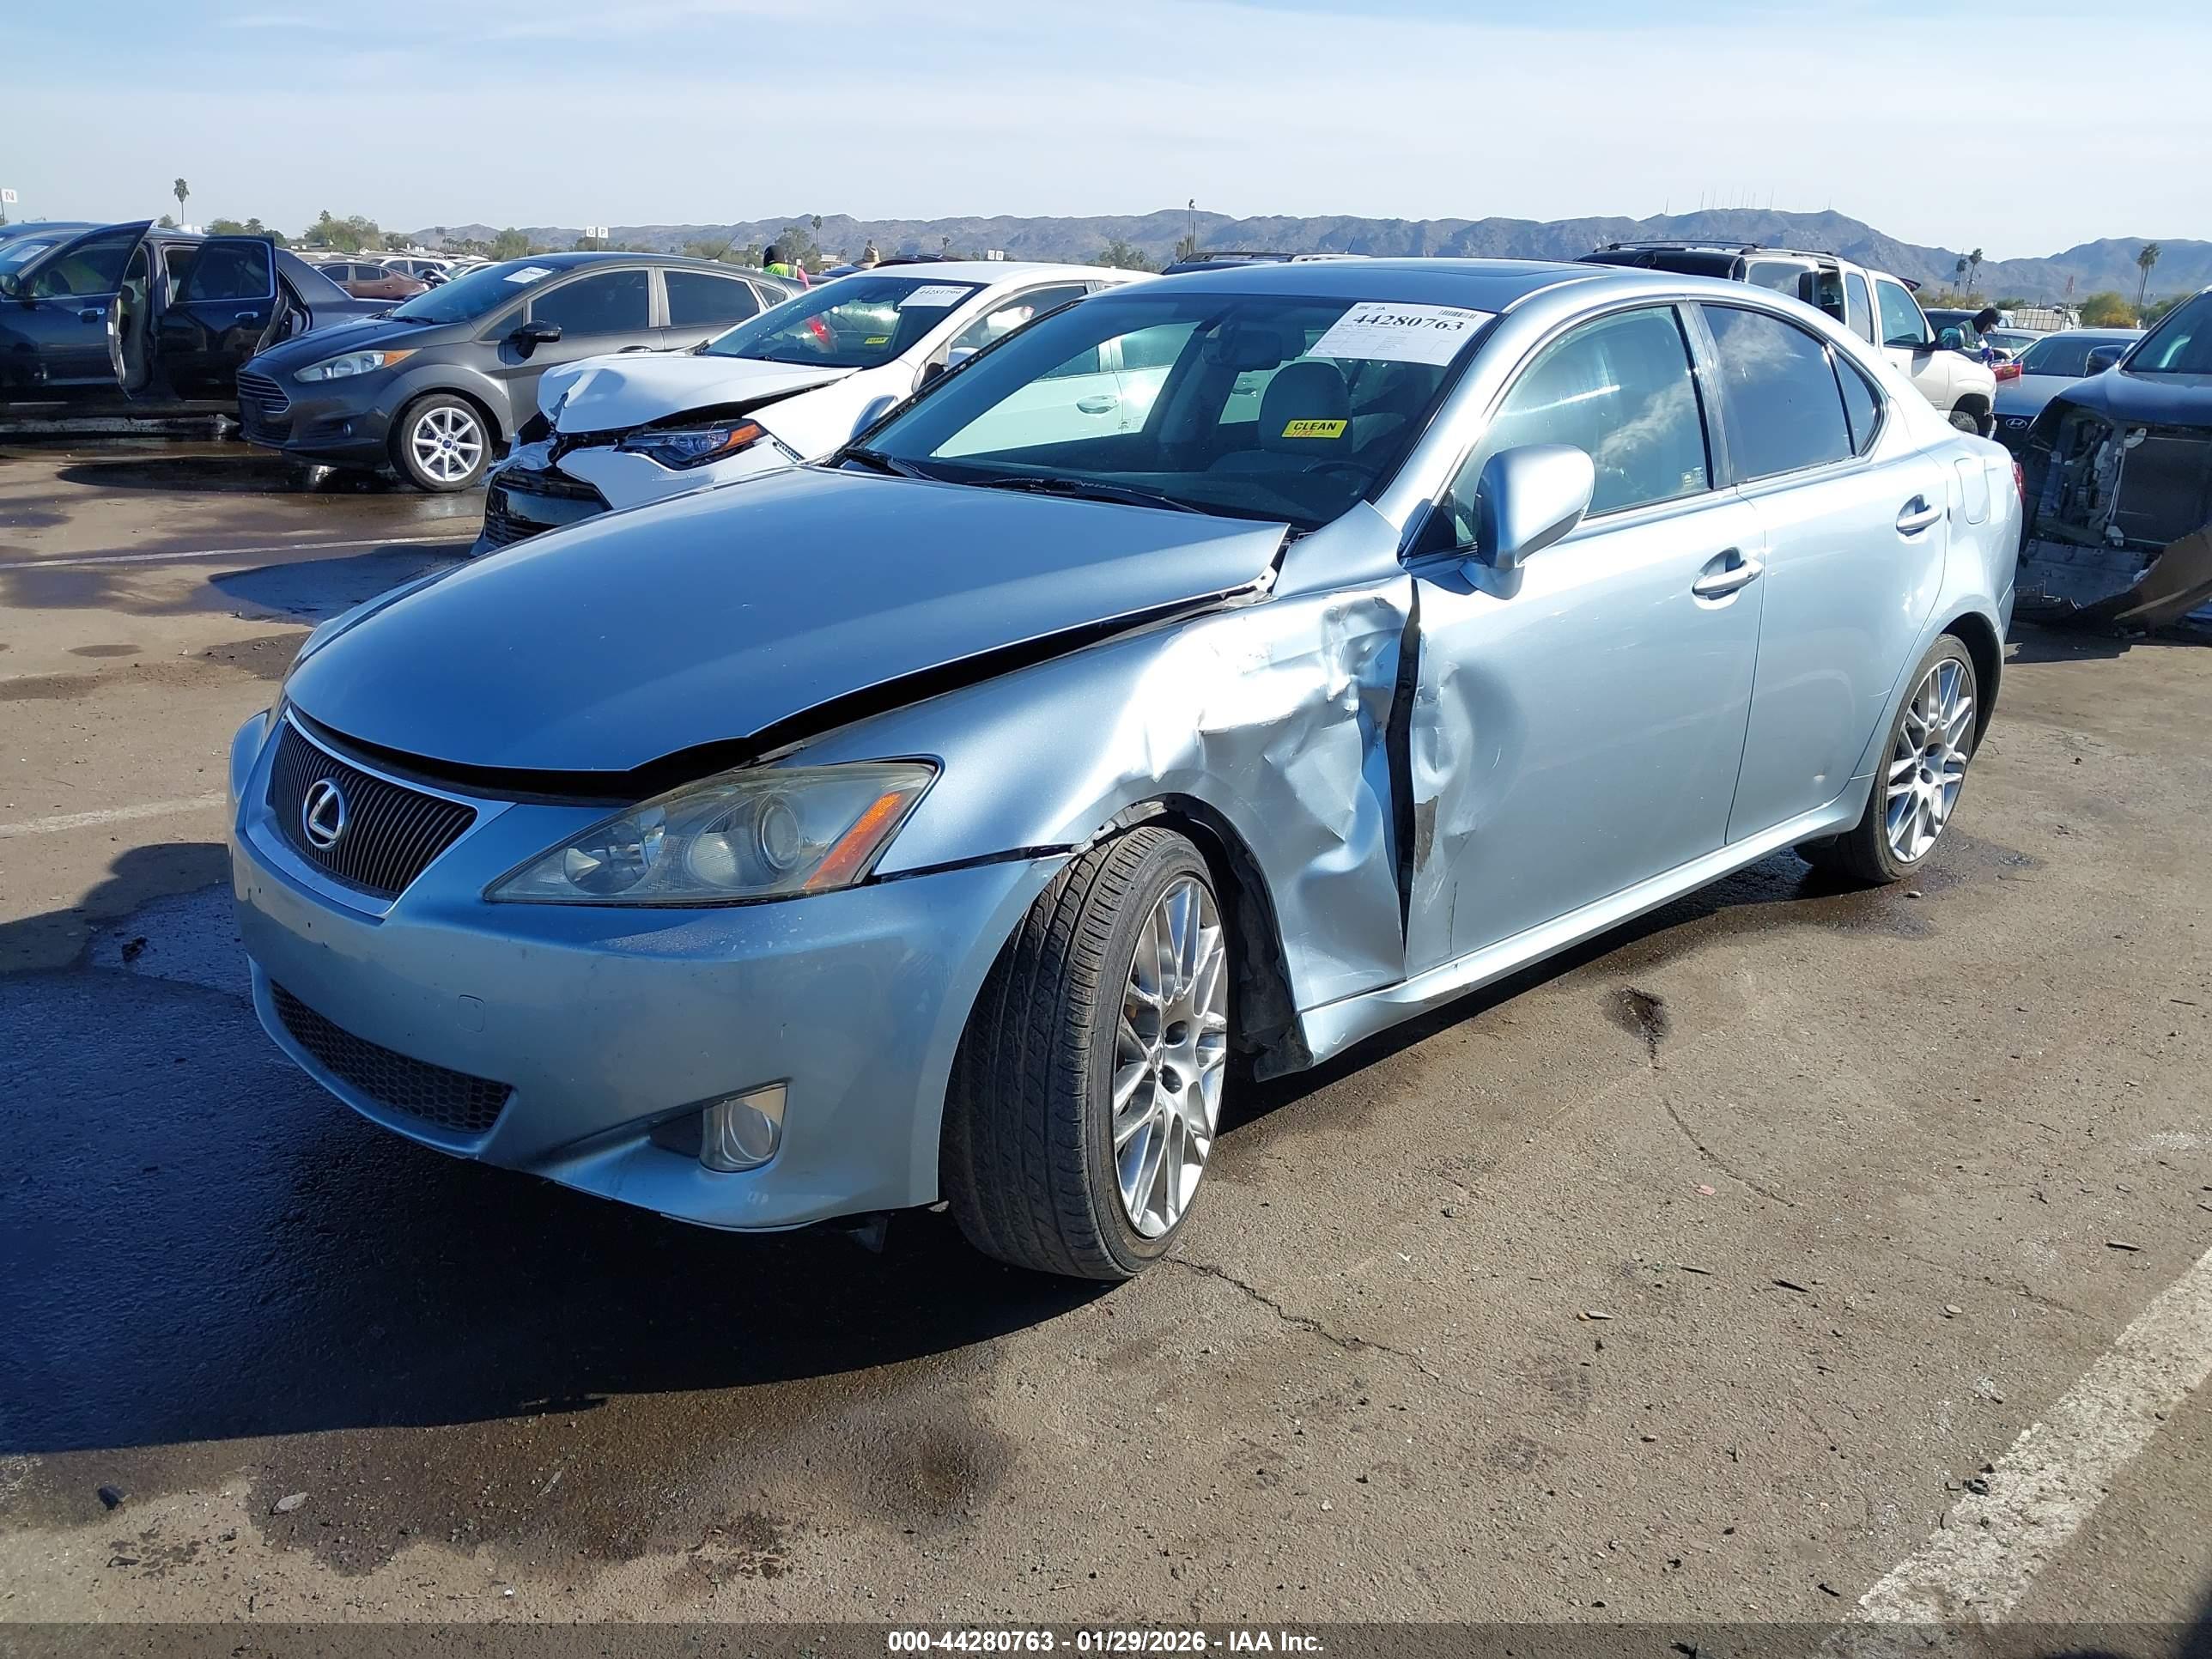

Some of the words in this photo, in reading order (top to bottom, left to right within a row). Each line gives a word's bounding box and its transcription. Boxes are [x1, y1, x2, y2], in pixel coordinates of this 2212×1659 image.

[5, 191, 15, 201] N
[1353, 313, 1465, 331] 44280763
[1293, 422, 1337, 431] CLEAN
